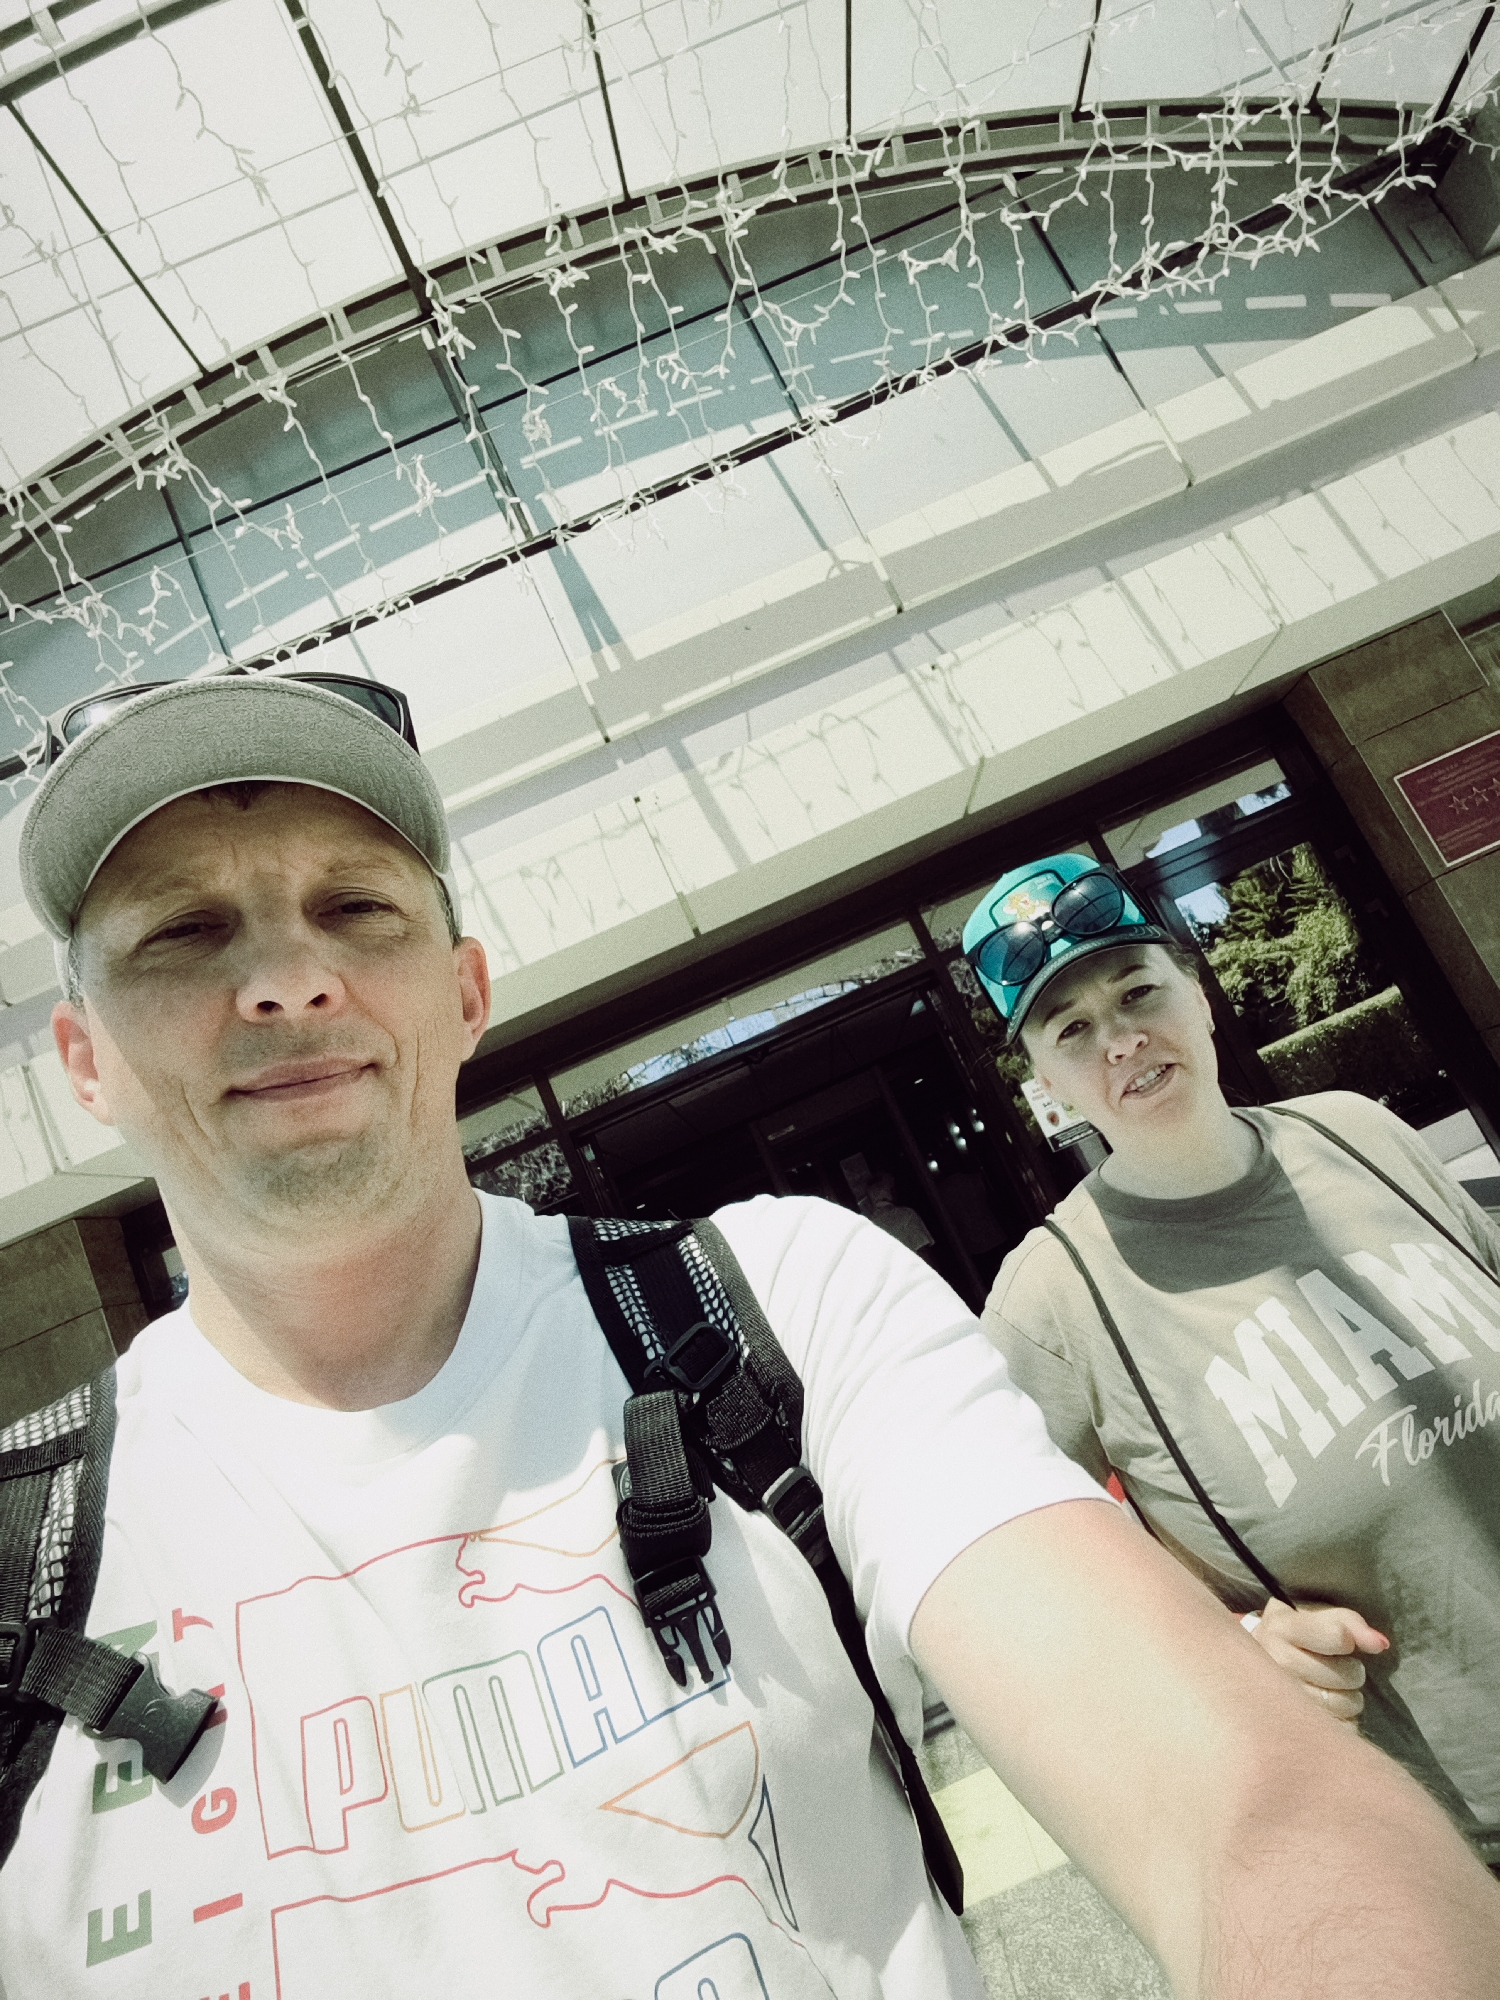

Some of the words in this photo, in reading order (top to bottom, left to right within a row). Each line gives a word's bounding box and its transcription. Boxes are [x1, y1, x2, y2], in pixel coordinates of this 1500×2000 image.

[1204, 1243, 1500, 1508] MIAMI
[1355, 1379, 1500, 1487] Florida
[172, 1607, 251, 2000] IGT
[300, 1606, 650, 1855] PUMA
